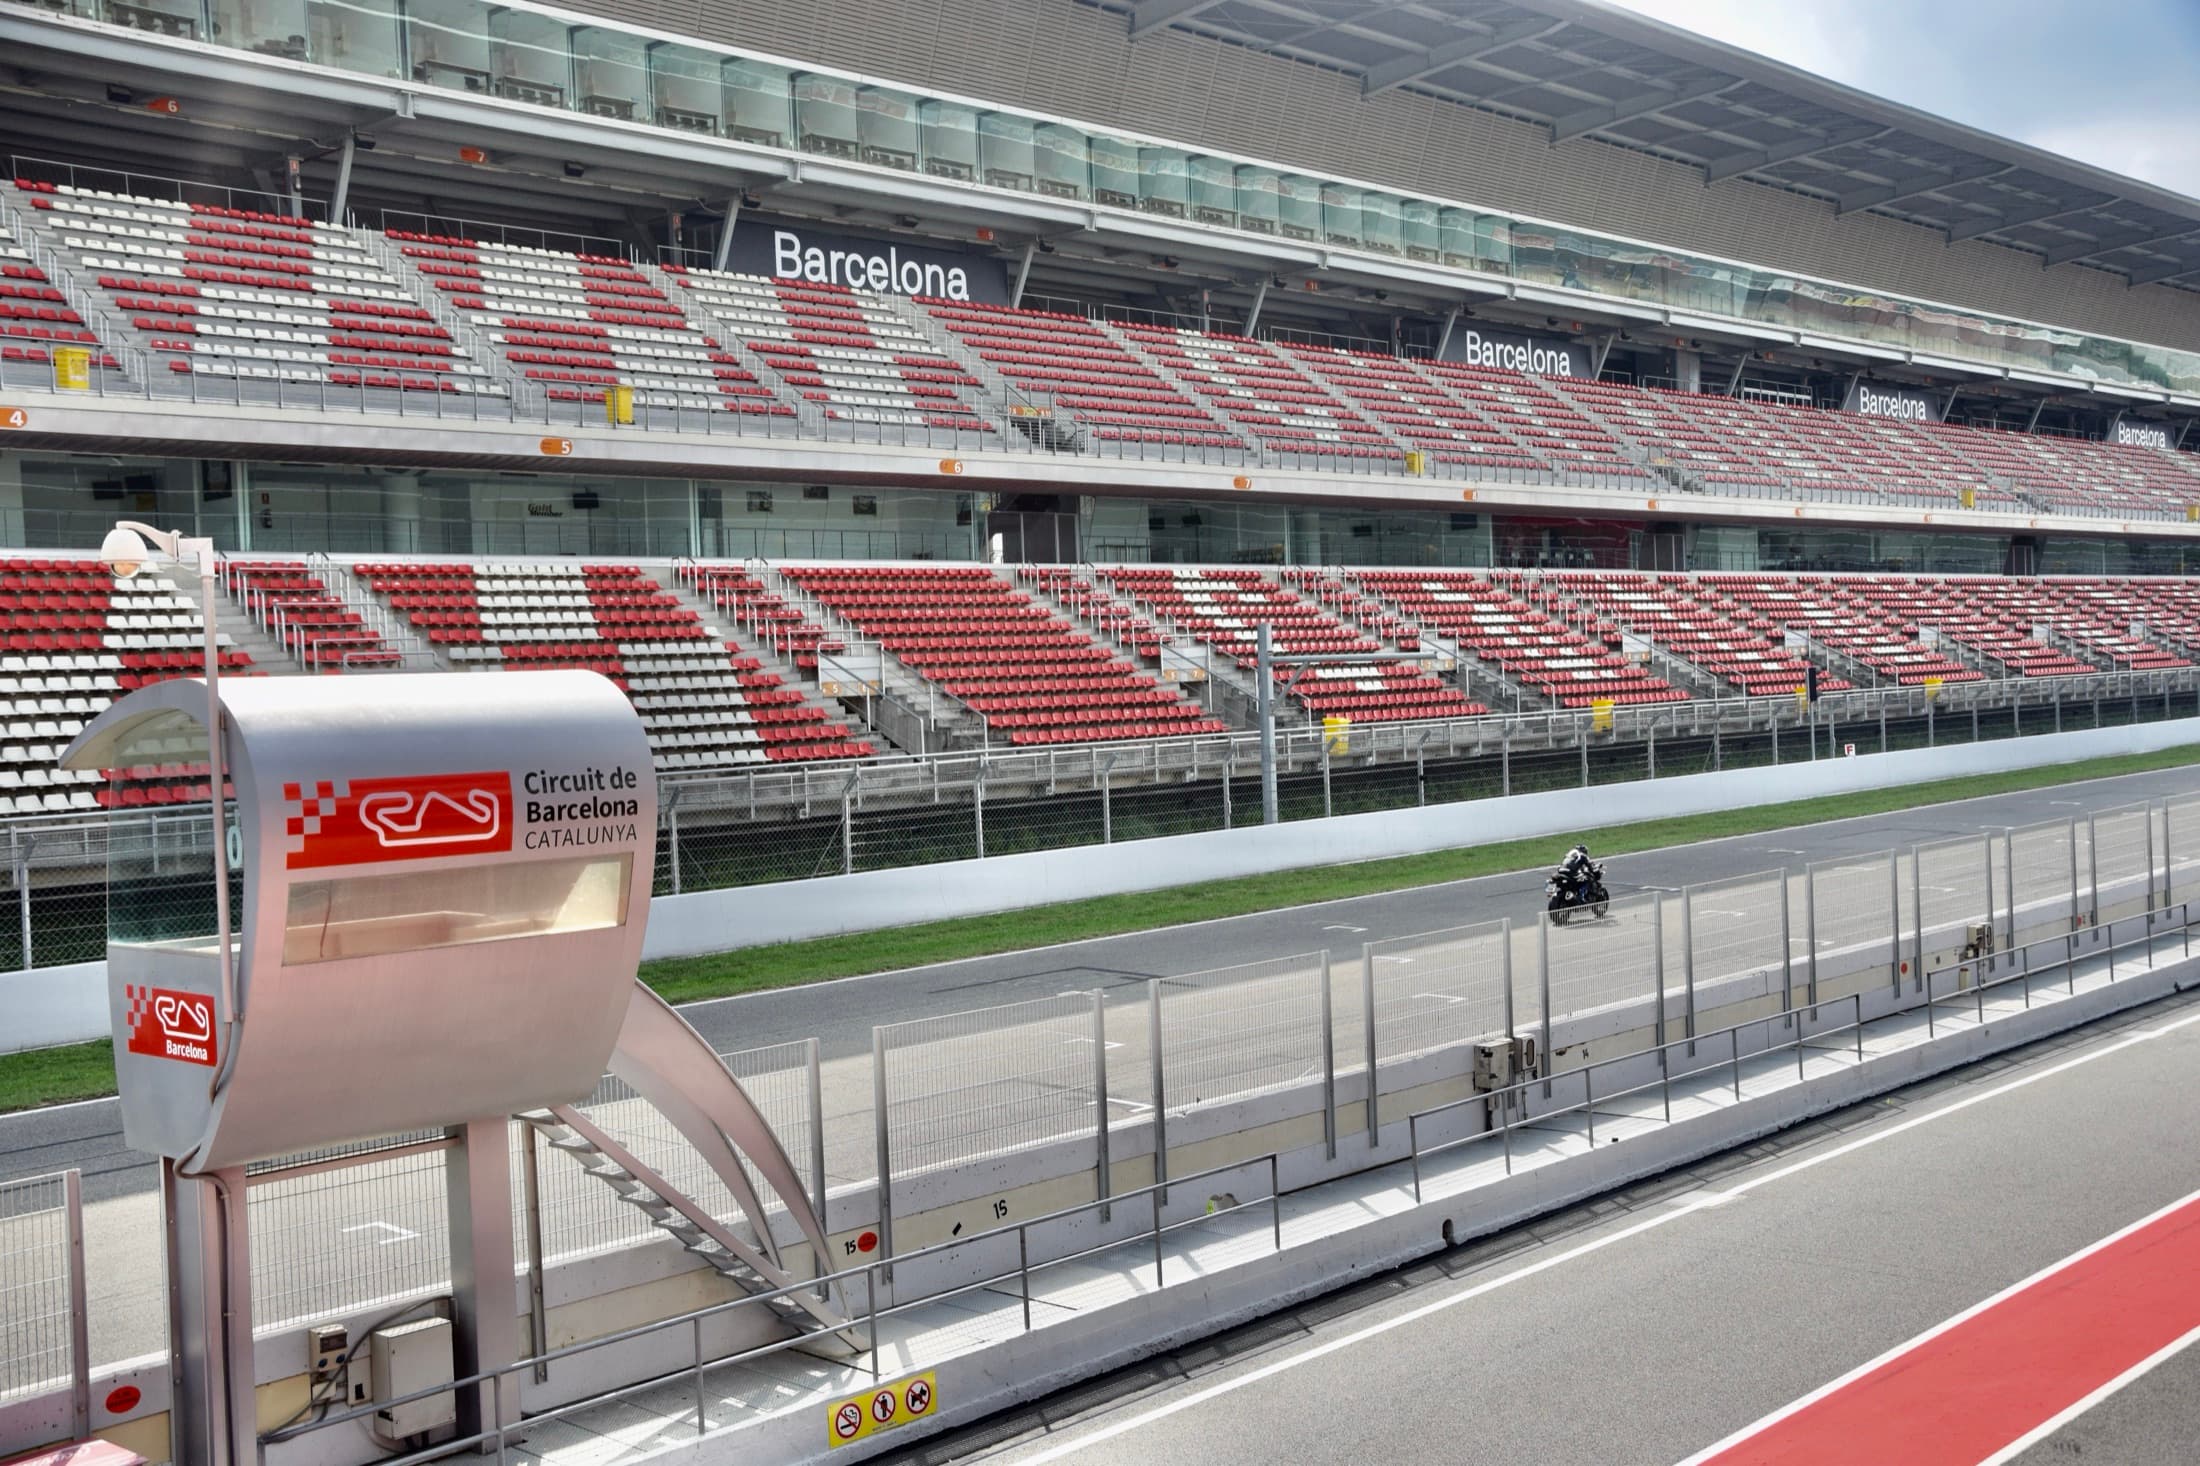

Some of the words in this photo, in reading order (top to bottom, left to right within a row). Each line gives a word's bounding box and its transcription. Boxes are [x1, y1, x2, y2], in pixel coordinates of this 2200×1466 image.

[167, 100, 178, 113] 6
[477, 151, 486, 162] 7
[774, 230, 970, 301] Barcelona
[1466, 330, 1571, 377] Barcelona
[1859, 386, 1927, 420] Barcelona
[9, 410, 24, 427] 4
[2118, 421, 2166, 448] Barcelona
[561, 440, 570, 454] 5
[953, 461, 962, 473] 6
[1245, 478, 1251, 489] 7
[1846, 745, 1853, 755] F
[524, 769, 606, 794] Circuit
[610, 766, 637, 789] de
[527, 796, 638, 823] Barcelona
[525, 824, 637, 849] CATALUNYA
[166, 1039, 208, 1061] Barcelona
[993, 1199, 1008, 1219] 15
[844, 1239, 857, 1256] 15
